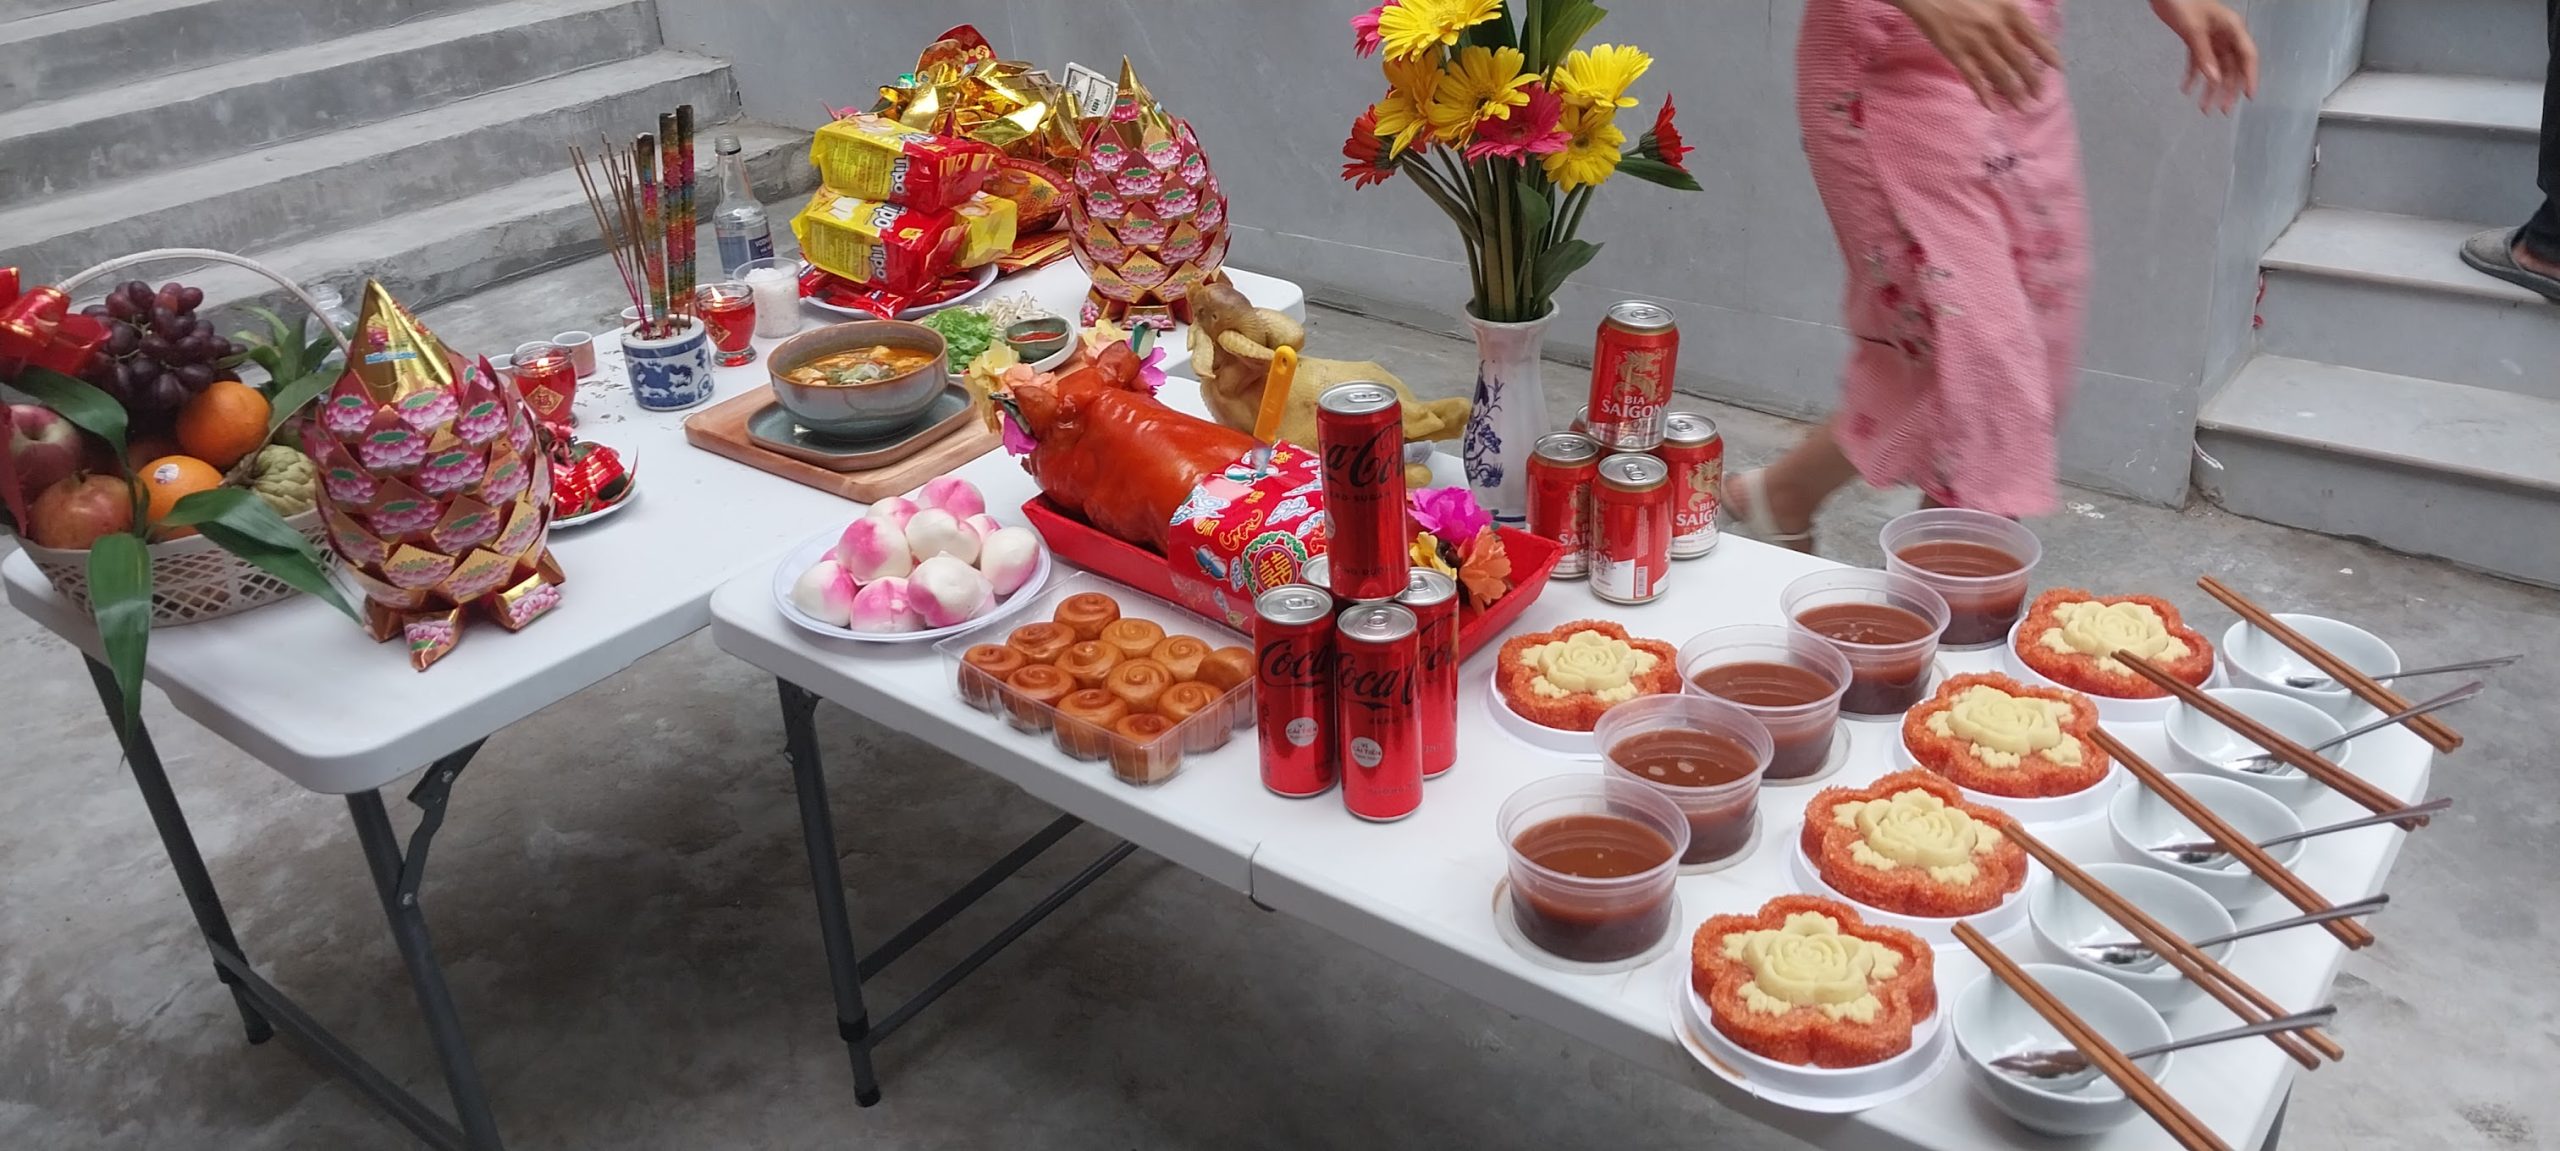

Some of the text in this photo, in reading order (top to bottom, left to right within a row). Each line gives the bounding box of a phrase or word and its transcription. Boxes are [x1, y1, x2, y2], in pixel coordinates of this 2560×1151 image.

[1624, 395, 1645, 405] BIA
[1601, 399, 1664, 419] SAIGON
[1699, 500, 1716, 512] BIA
[1676, 504, 1721, 527] SAIGO
